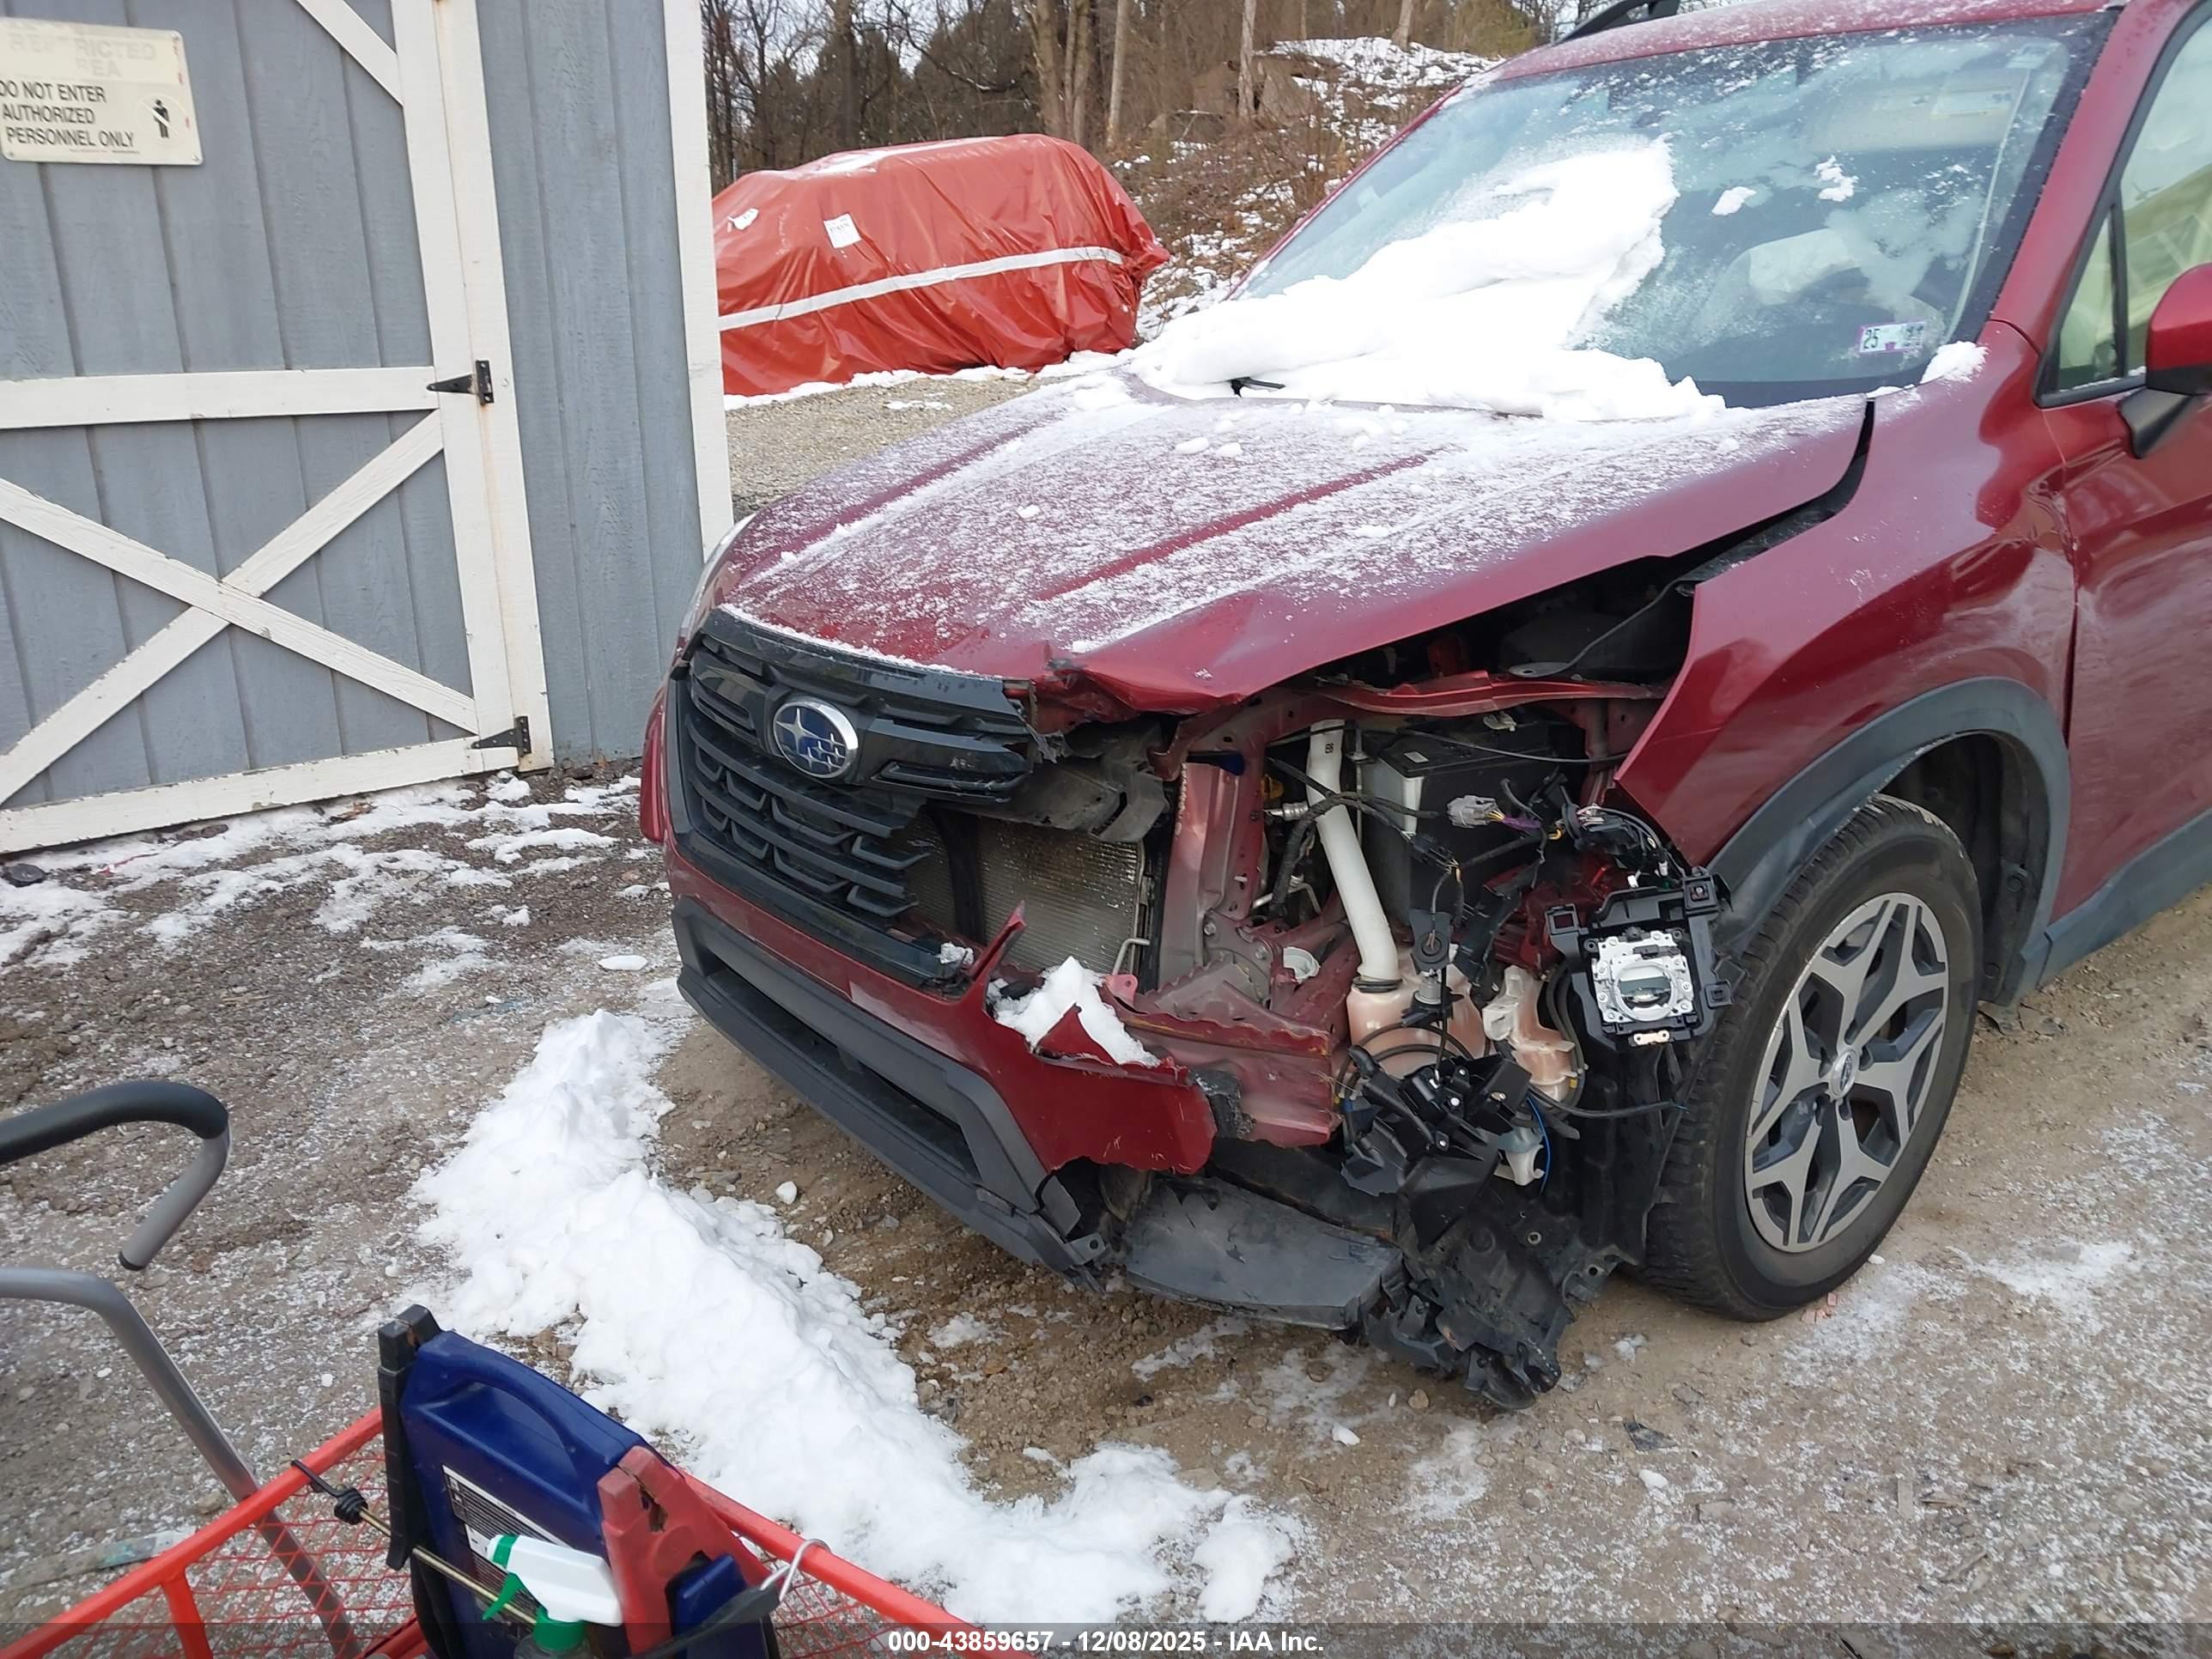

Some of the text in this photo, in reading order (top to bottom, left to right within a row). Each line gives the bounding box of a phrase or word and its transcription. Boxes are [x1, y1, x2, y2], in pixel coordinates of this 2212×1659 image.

[0, 80, 106, 104] DO NOT ENTER
[3, 103, 96, 124] AUTHORIZED
[6, 126, 135, 148] PERSONNEL ONLY
[1863, 328, 1881, 349] 25
